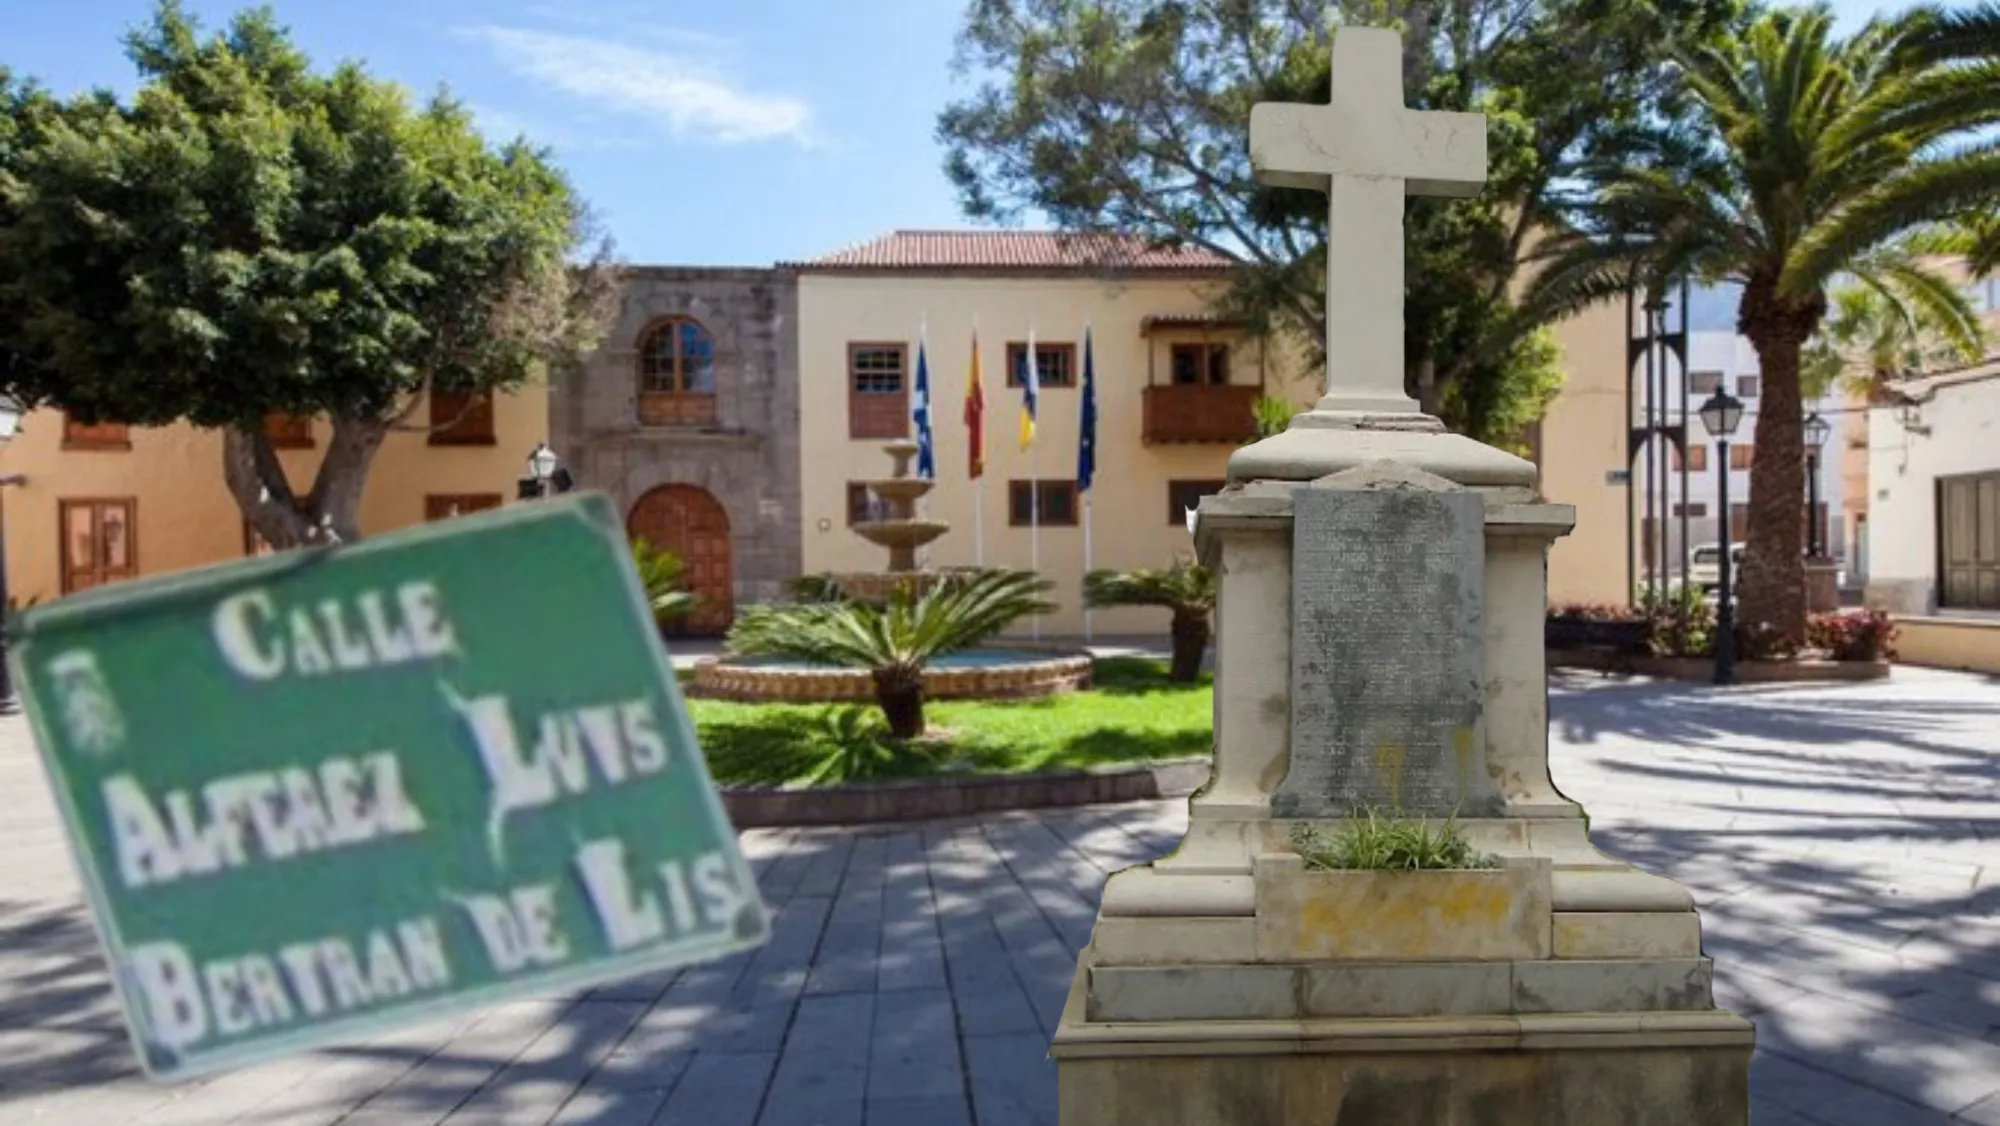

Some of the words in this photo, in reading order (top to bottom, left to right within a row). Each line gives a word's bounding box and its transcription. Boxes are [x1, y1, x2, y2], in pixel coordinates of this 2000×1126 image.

[214, 583, 461, 679] CALLE
[103, 751, 426, 886] ALFEREZ
[130, 916, 449, 1048] BERTRAN
[448, 881, 569, 972] DE
[576, 838, 741, 951] LIS
